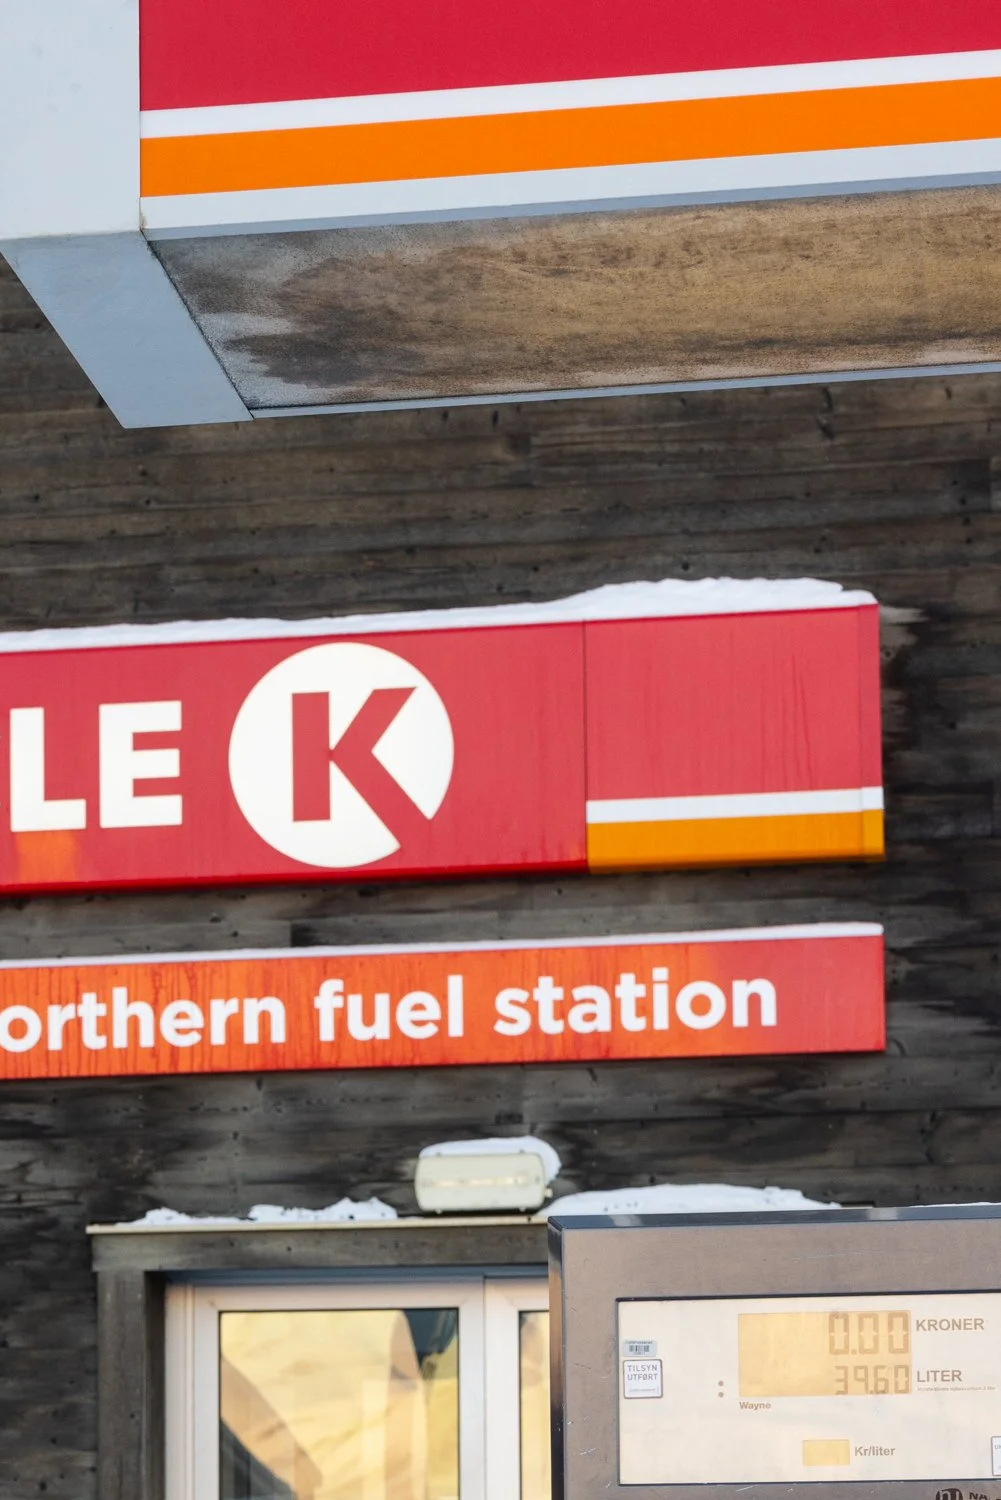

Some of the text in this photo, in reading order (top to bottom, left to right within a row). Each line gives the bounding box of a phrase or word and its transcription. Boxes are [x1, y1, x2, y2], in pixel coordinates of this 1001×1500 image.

[290, 685, 435, 851] K
[314, 974, 465, 1042] fuel
[492, 966, 778, 1037] station
[829, 1312, 985, 1355] 0.00 KRONER
[627, 1364, 658, 1372] TILSYN
[916, 1369, 963, 1383] LITER
[739, 1401, 771, 1411] Wayne
[854, 1445, 896, 1457] Kr/liter
